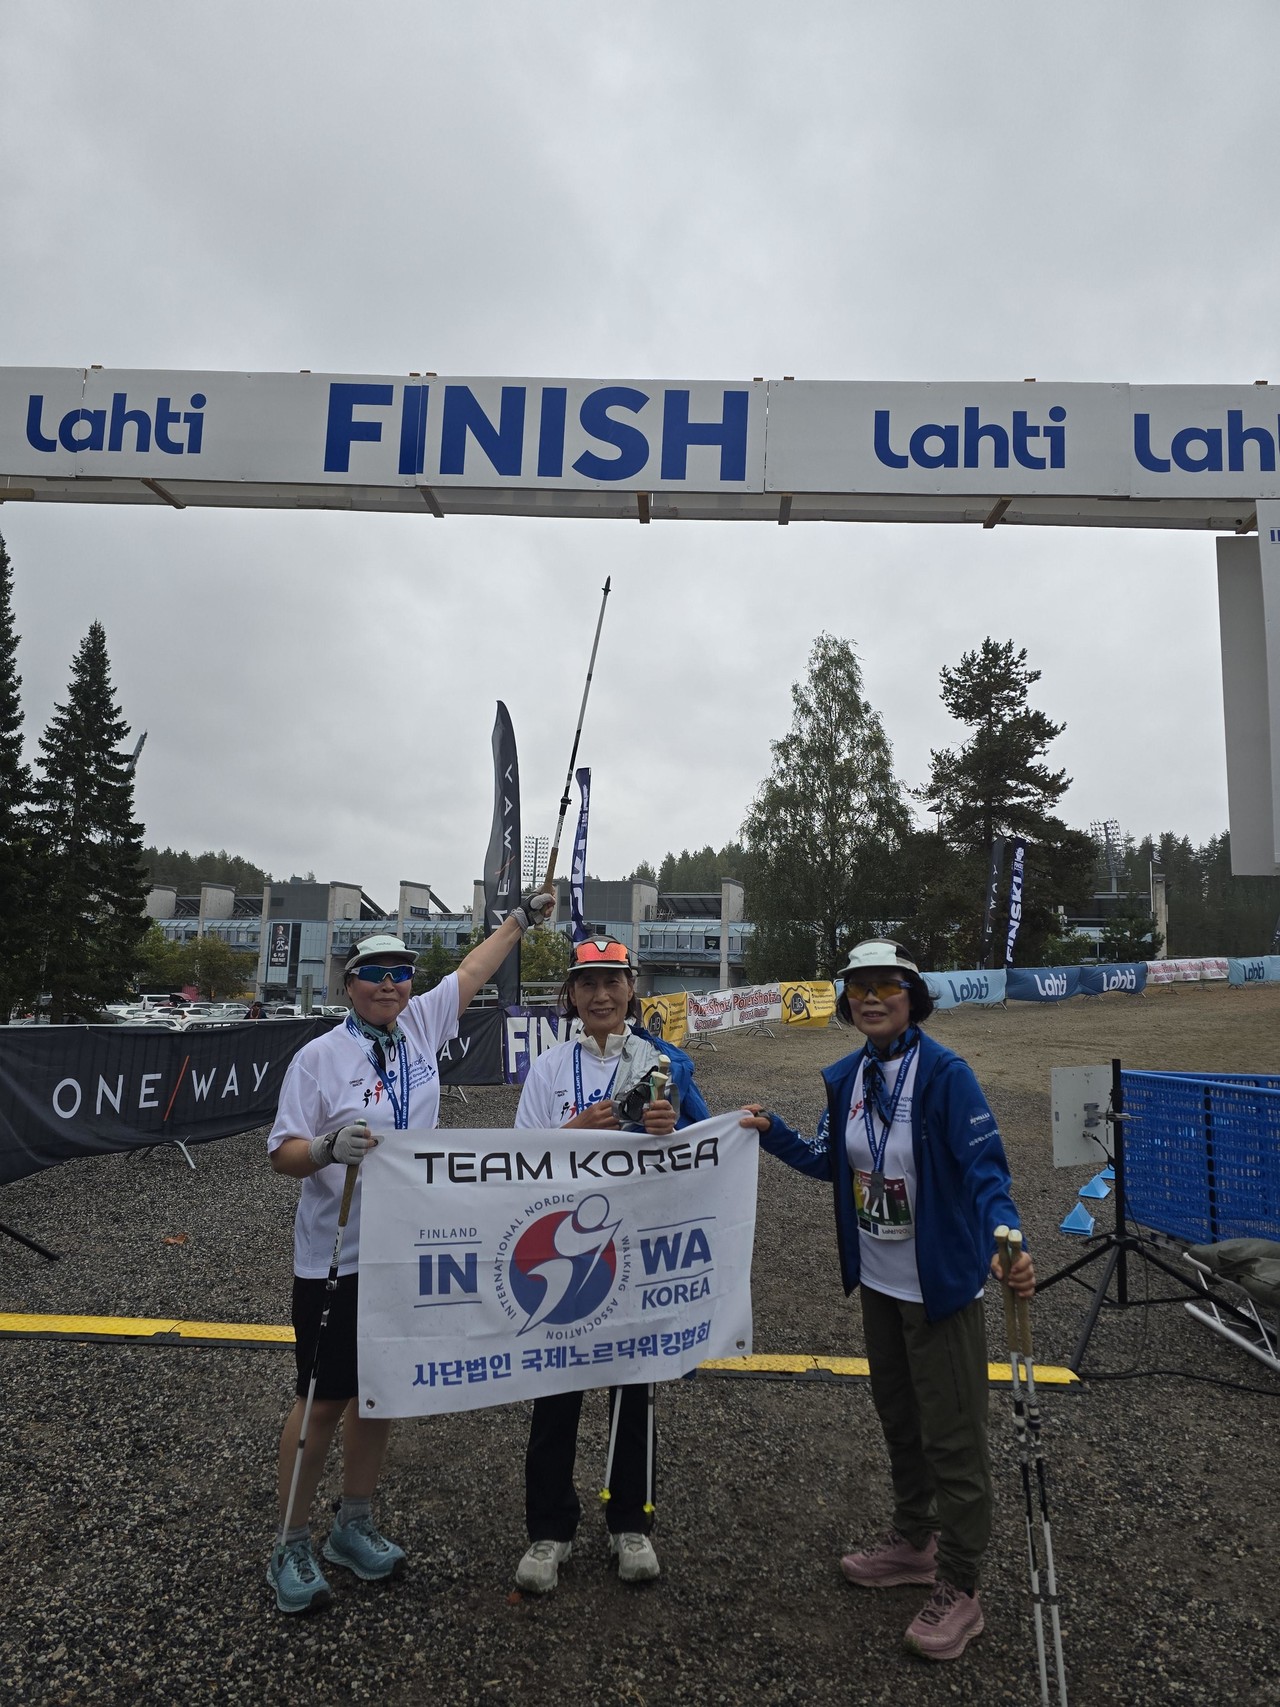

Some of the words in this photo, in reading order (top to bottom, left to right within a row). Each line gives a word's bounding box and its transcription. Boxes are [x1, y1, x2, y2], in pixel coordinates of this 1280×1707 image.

[26, 393, 207, 455] Lahti
[323, 382, 749, 482] FINISH
[874, 405, 1067, 470] Lahti
[1134, 409, 1280, 473] Lah
[1006, 875, 1022, 963] FINSKI
[948, 975, 989, 1003] Lahti
[1034, 972, 1067, 996] Lahti
[1102, 969, 1136, 992] Lahti
[414, 1150, 554, 1184] TEAM
[569, 1136, 719, 1180] KOREA
[524, 1194, 575, 1217] NORDIC
[419, 1227, 477, 1239] FINLAND
[640, 1228, 713, 1276] WA
[419, 1253, 478, 1297] IN
[494, 1217, 524, 1320] INTERNATIONAL
[618, 1235, 631, 1292] WALKING
[546, 1297, 619, 1340] ASSOCIATION
[641, 1280, 711, 1310] KOREA
[412, 1352, 511, 1387] 사단법인
[521, 1319, 711, 1372] 국제노르딕워킹협회
